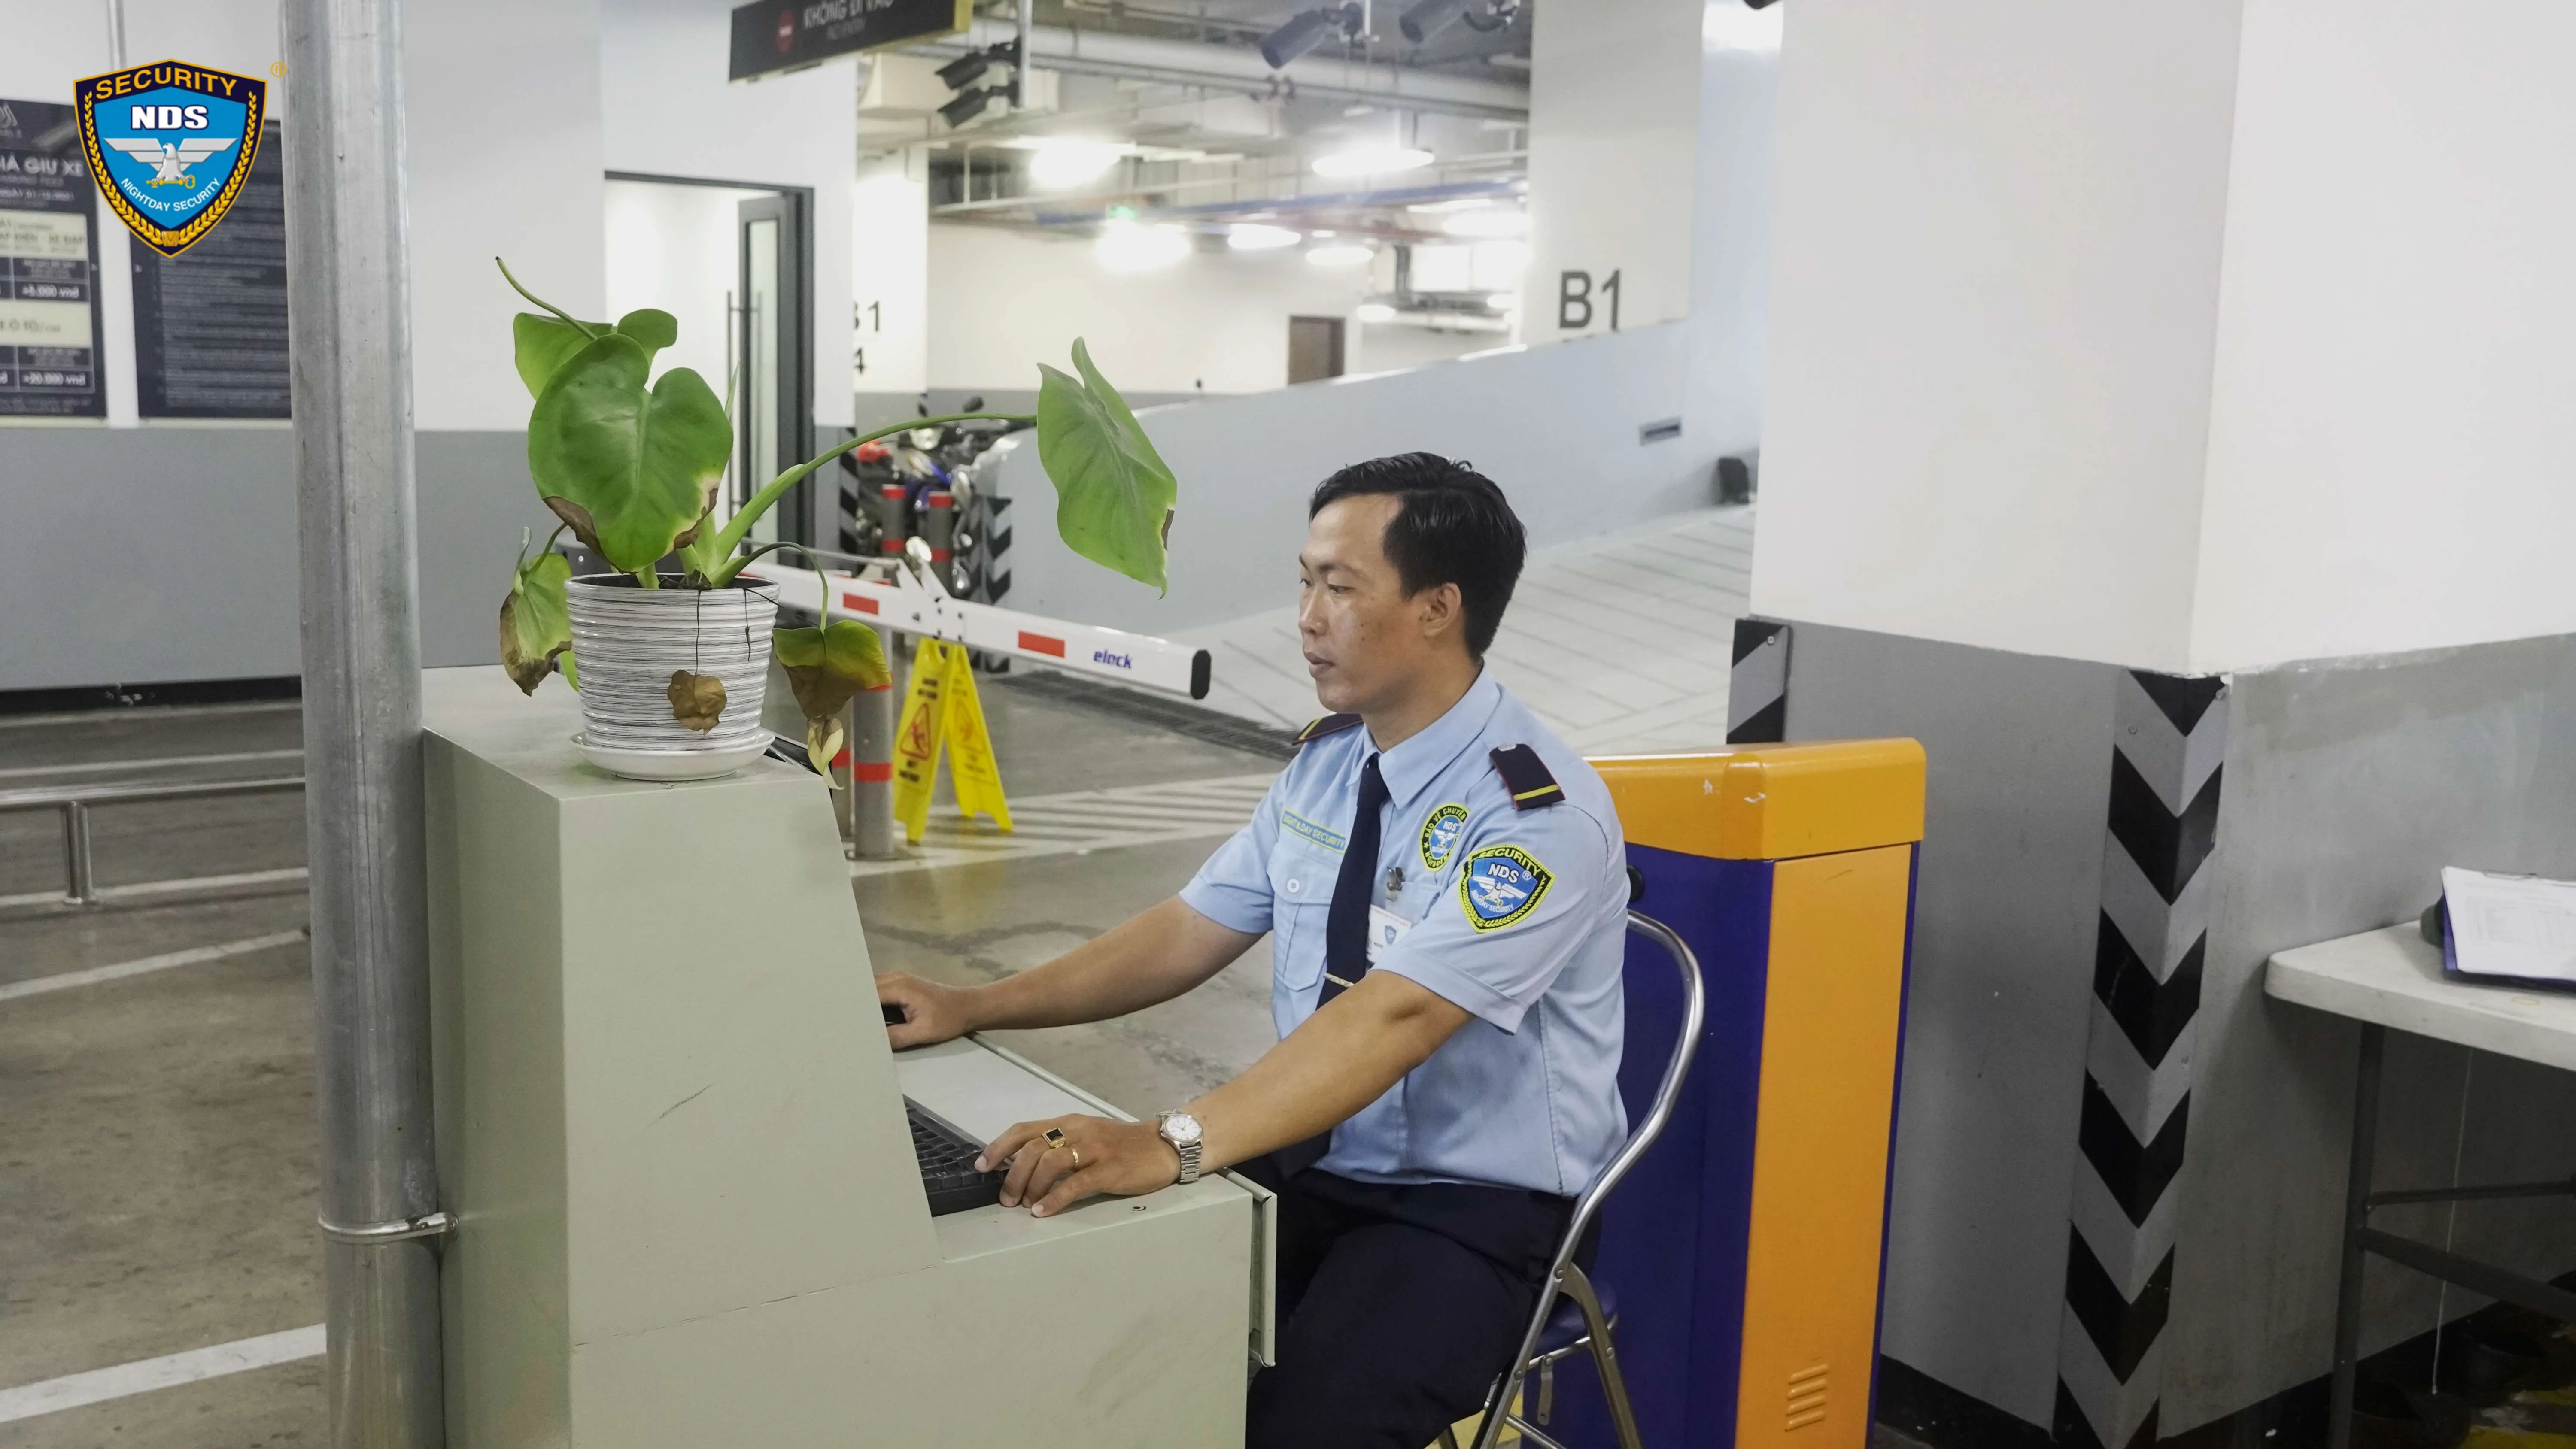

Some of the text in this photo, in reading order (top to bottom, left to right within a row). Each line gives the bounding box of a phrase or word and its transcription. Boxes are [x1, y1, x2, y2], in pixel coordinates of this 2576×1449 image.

[1559, 269, 1620, 331] B1
[1443, 820, 1458, 832] NDS
[1479, 848, 1542, 876] SECURITY
[1488, 863, 1519, 883] NDS
